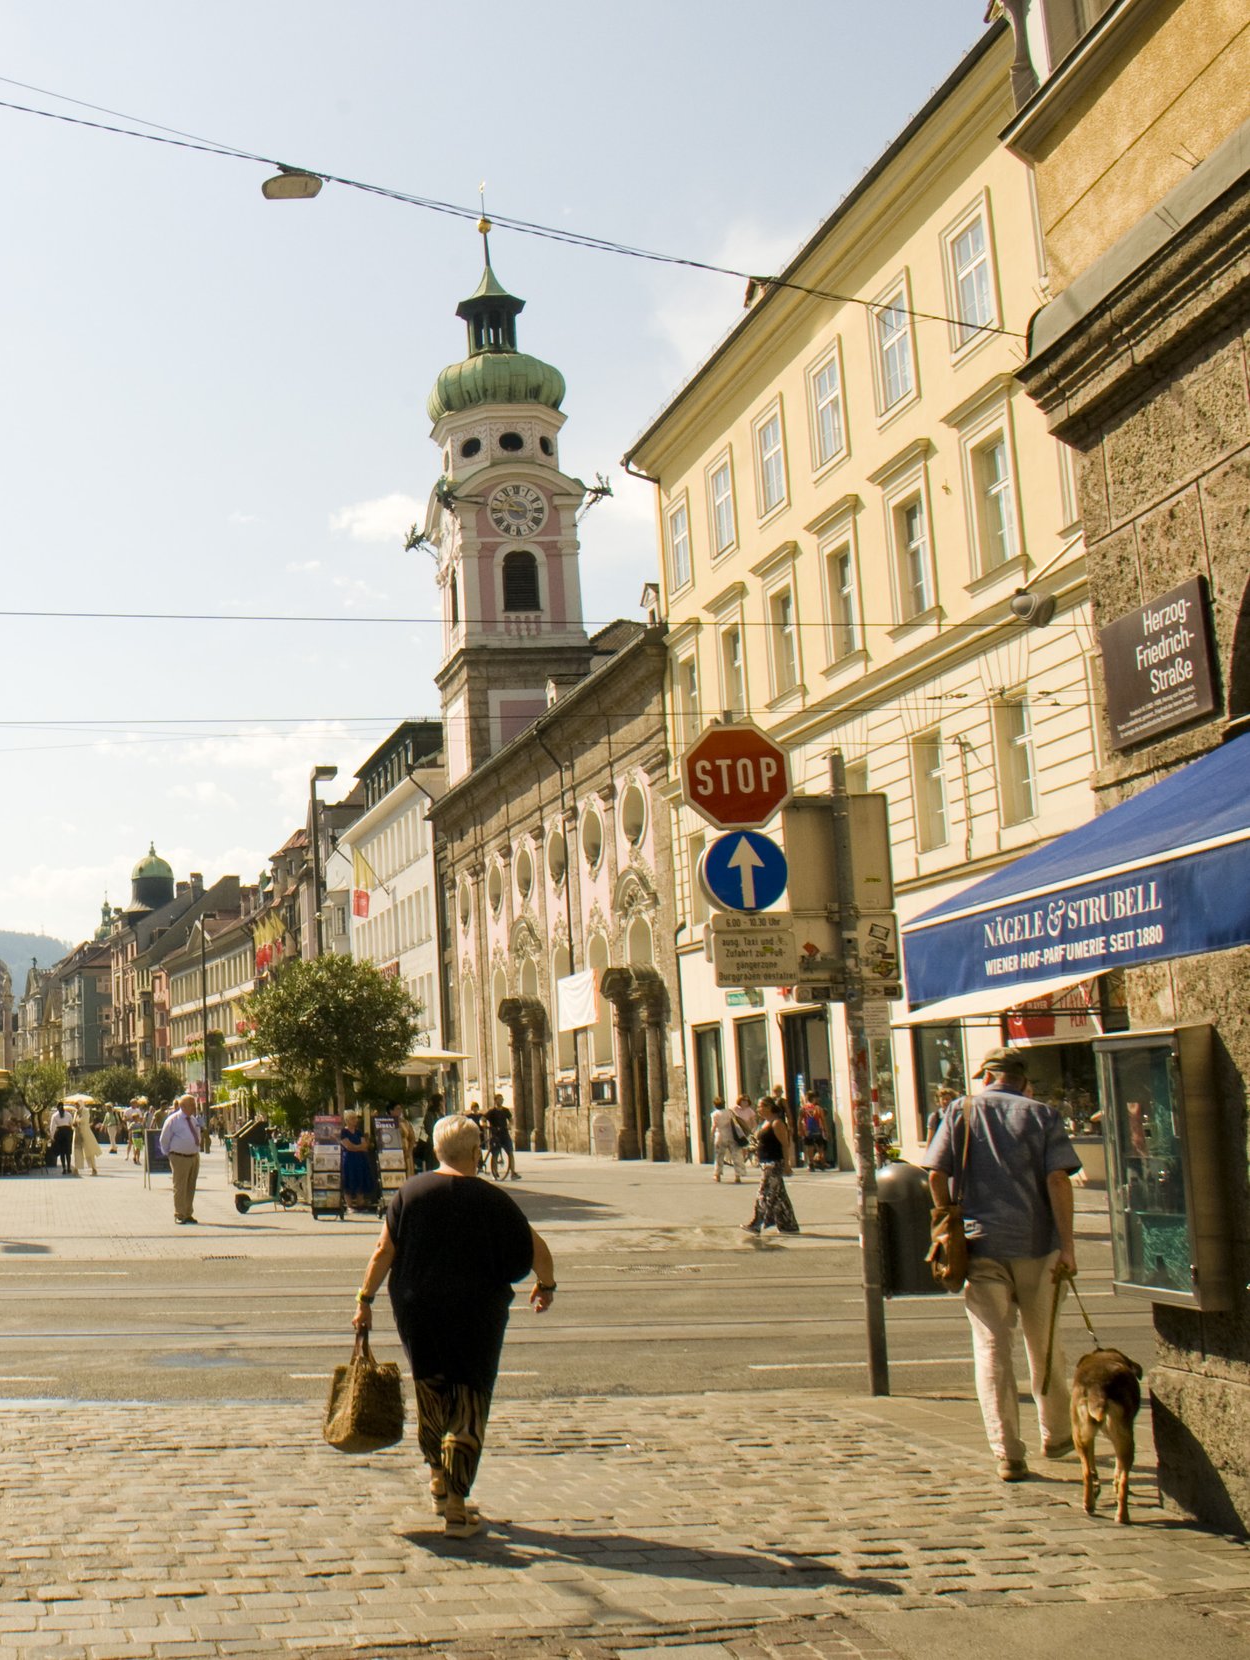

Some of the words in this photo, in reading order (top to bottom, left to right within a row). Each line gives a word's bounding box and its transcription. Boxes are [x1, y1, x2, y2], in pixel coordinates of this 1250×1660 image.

[1142, 599, 1191, 636] Herzog-
[1136, 625, 1195, 670] Friedrich-
[1150, 657, 1193, 694] Straße
[695, 757, 778, 796] STOP
[768, 918, 781, 926] Uhr
[983, 910, 1044, 948] NÄGELE
[1046, 899, 1066, 937] &
[1067, 881, 1163, 930] STRUBELL
[725, 948, 753, 958] Zufahrt
[744, 937, 758, 946] Taxi
[760, 937, 774, 946] und
[985, 954, 1019, 976] WIENER
[1020, 936, 1107, 969] HOF-PARFUMERIE
[1109, 929, 1135, 953] SEIT
[1136, 924, 1164, 947] 1880
